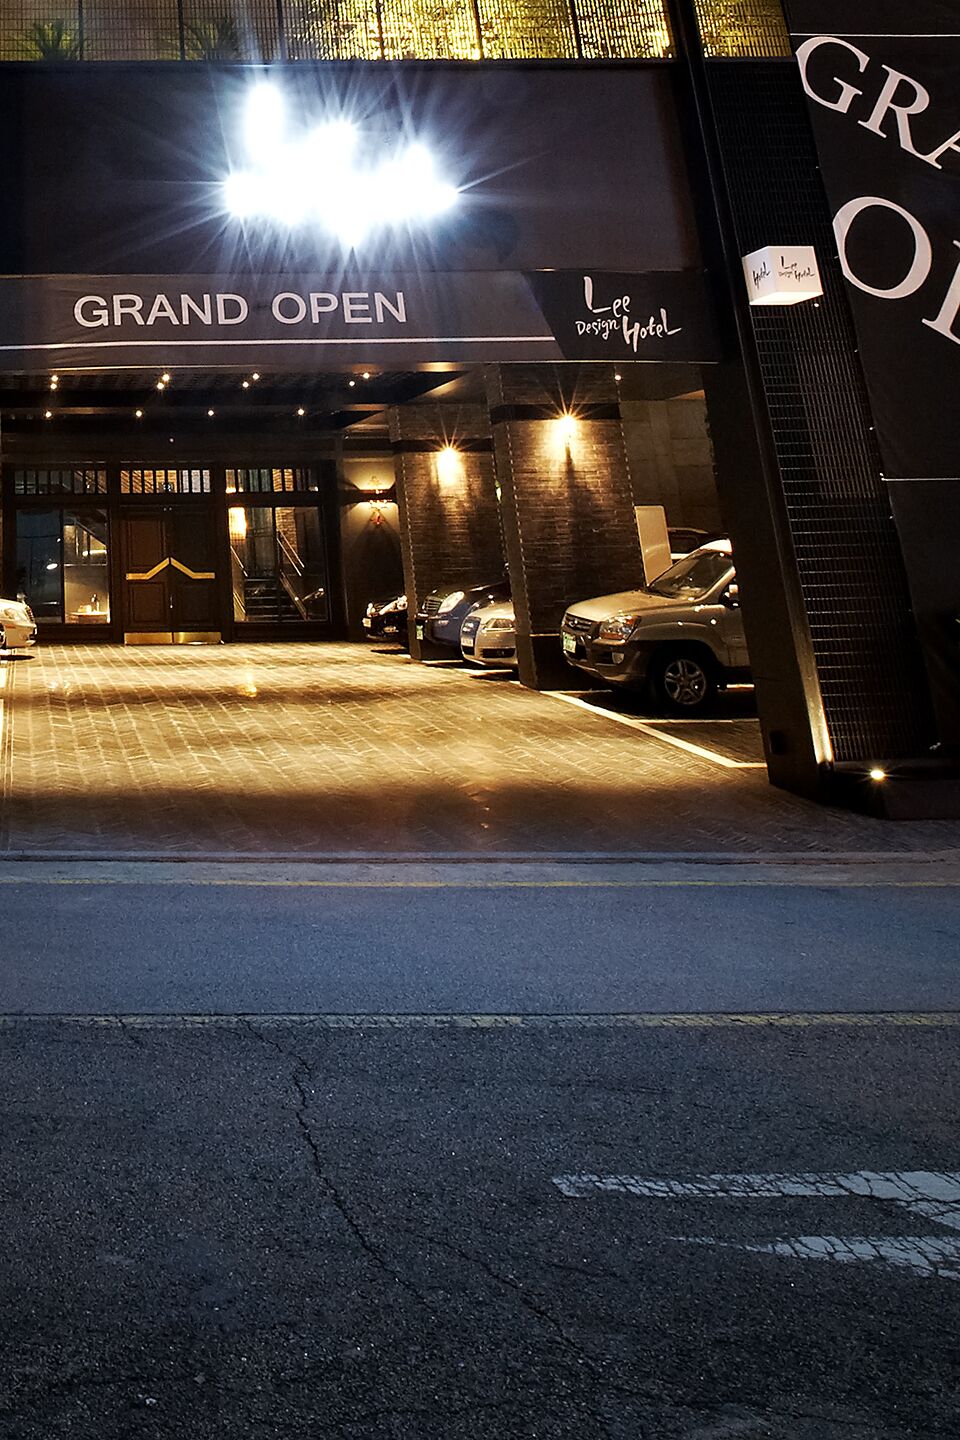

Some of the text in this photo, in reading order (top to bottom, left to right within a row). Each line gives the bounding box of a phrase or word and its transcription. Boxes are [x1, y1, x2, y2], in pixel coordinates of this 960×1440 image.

[74, 292, 407, 327] GRAND OPEN
[584, 276, 630, 317] Lee
[575, 318, 620, 340] Design
